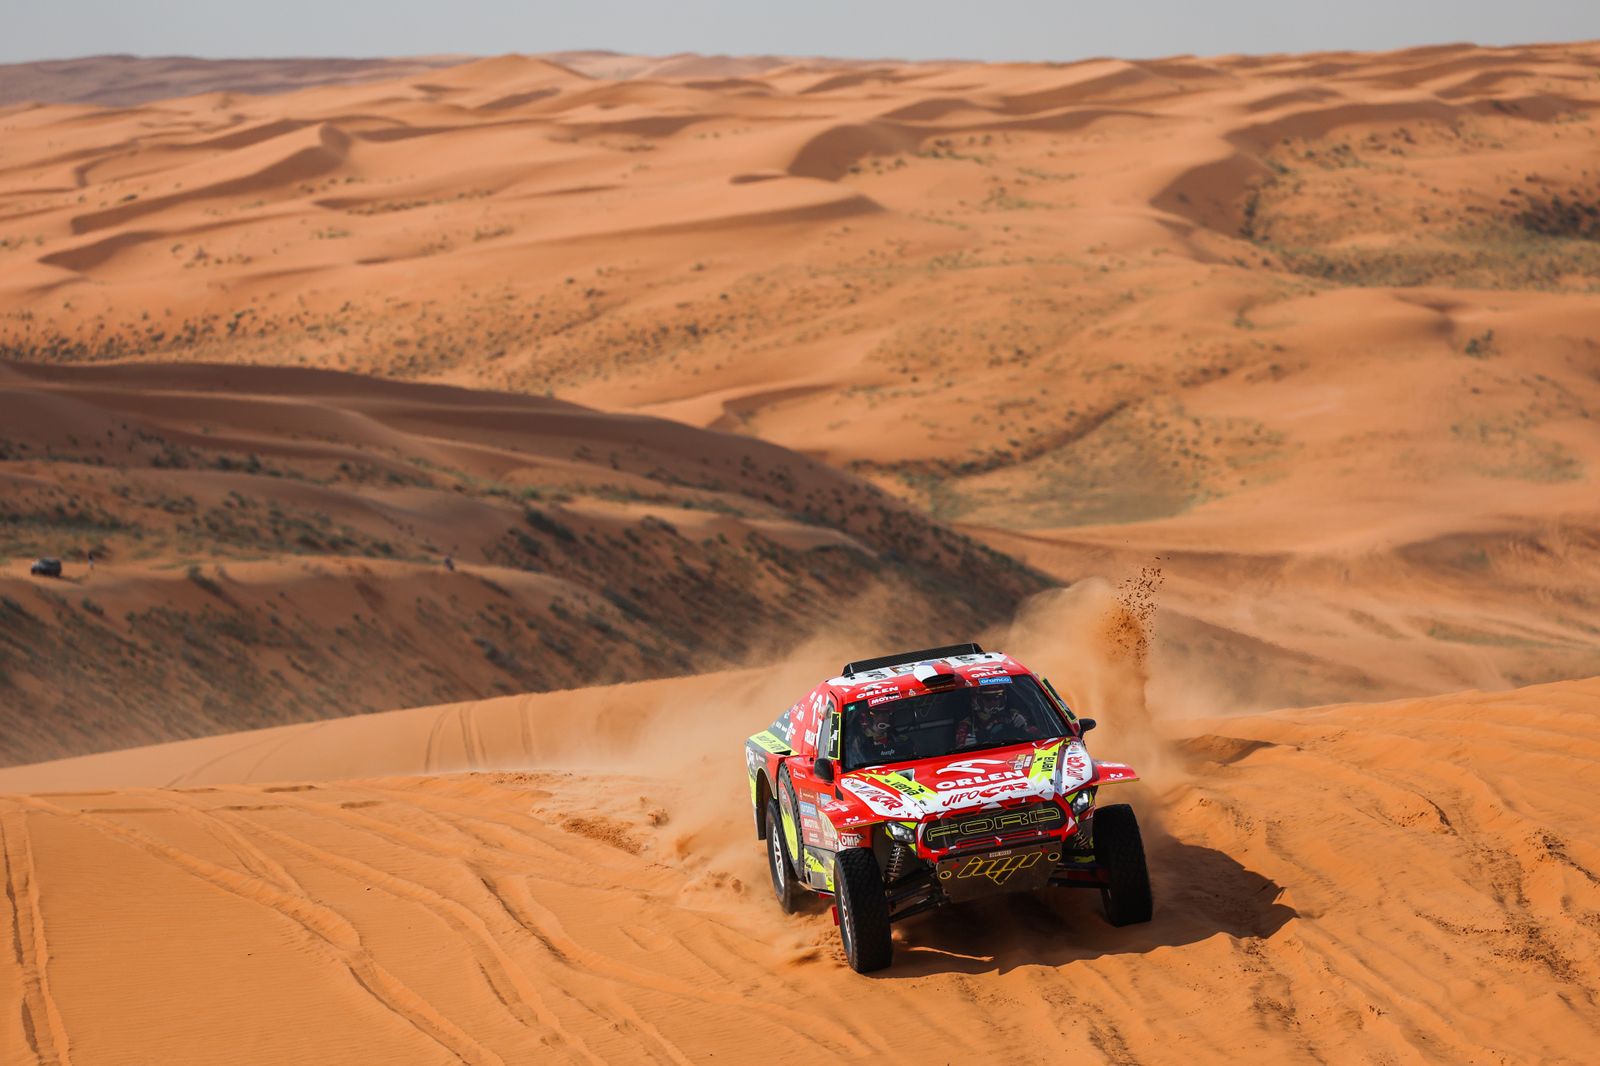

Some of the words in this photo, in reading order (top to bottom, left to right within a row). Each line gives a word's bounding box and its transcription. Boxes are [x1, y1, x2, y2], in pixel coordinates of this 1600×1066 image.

[971, 670, 1008, 678] ORLEN
[856, 686, 899, 699] ORLEN
[871, 695, 900, 705] MOTUL
[936, 770, 1025, 789] ORLEN
[927, 807, 1061, 842] FORD
[841, 835, 860, 846] OMP
